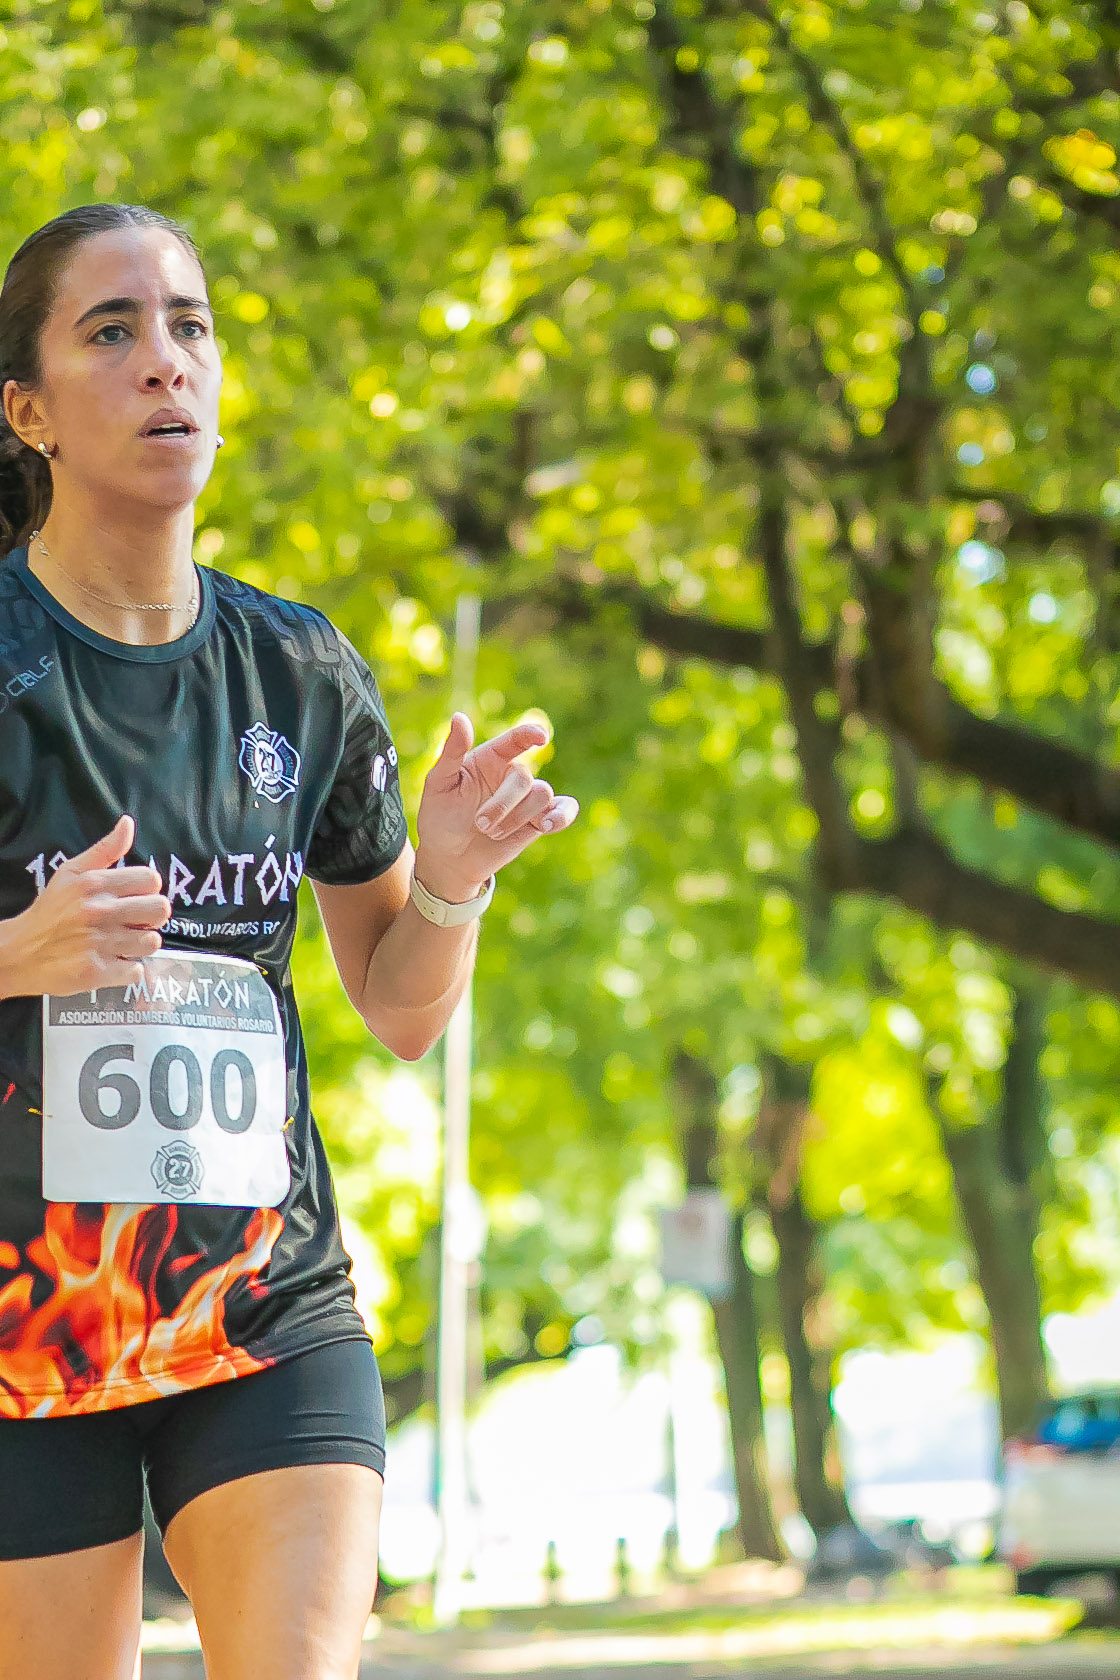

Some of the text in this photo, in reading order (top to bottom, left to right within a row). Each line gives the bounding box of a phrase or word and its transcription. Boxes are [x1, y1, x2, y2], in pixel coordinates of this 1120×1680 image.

[123, 967, 251, 1009] MARATÓN
[126, 1010, 180, 1025] BOMBEROS
[181, 1012, 237, 1030] VOLUNTARIOS
[237, 1017, 274, 1033] ROSARIO
[78, 1043, 257, 1134] 600
[168, 1158, 191, 1179] 27
